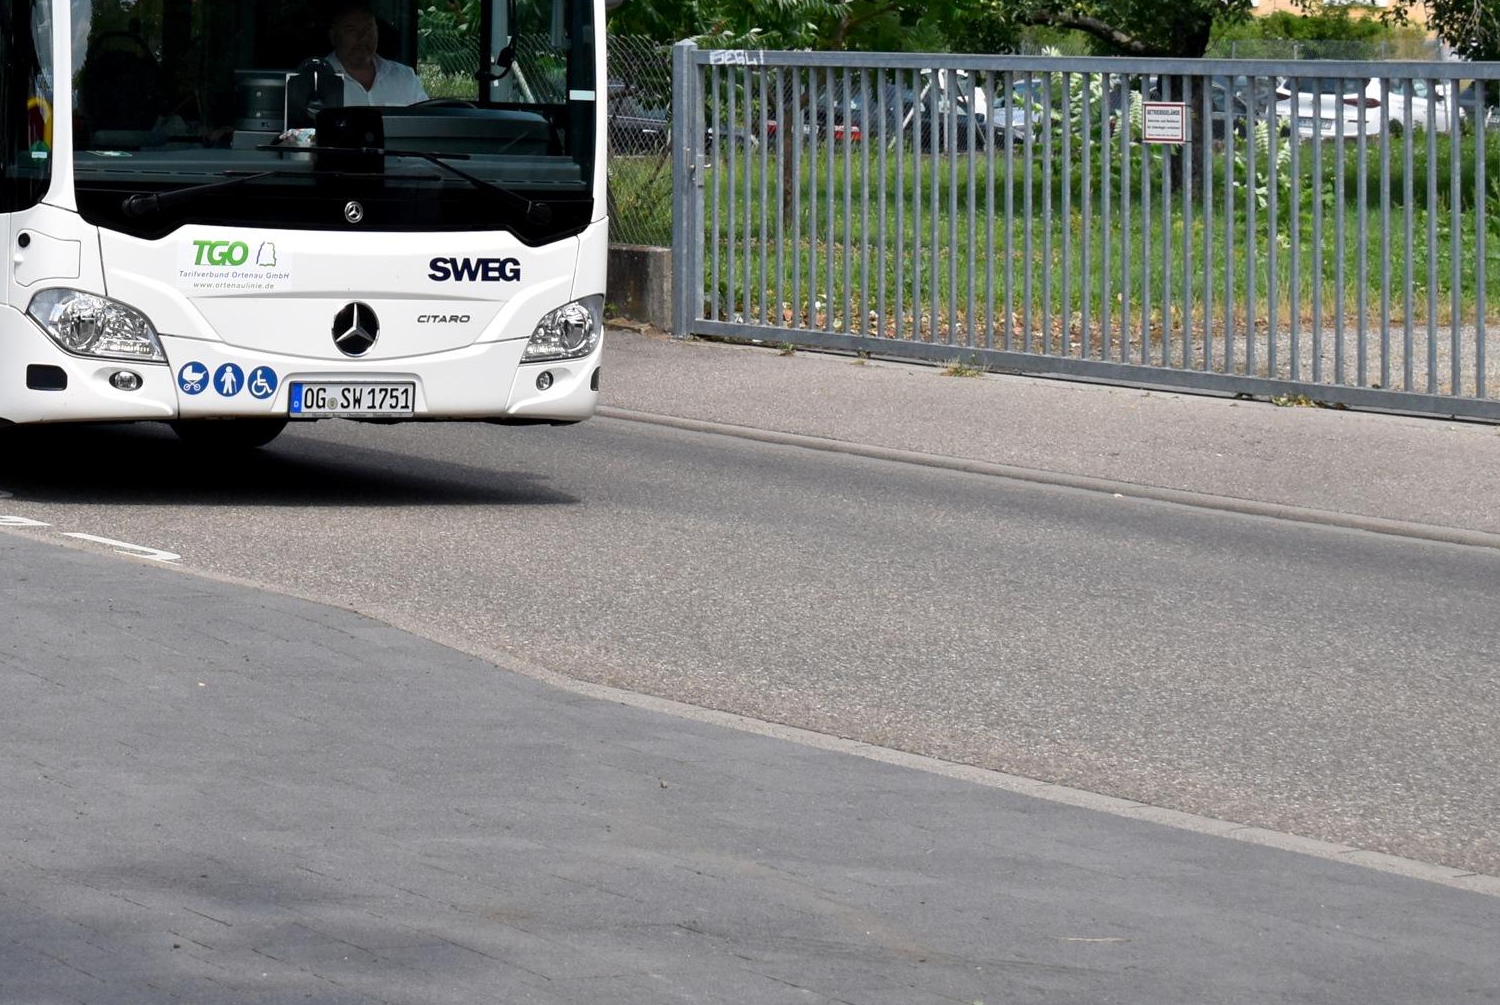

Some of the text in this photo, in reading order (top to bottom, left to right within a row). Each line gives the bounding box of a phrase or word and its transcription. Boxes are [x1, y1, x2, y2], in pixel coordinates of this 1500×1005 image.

[193, 240, 249, 266] TGO
[180, 270, 229, 278] Tarifverbund
[231, 271, 263, 279] Ortenau
[428, 257, 521, 282] SWEG
[417, 315, 471, 323] CITARO
[304, 387, 410, 409] OG SW 1751
